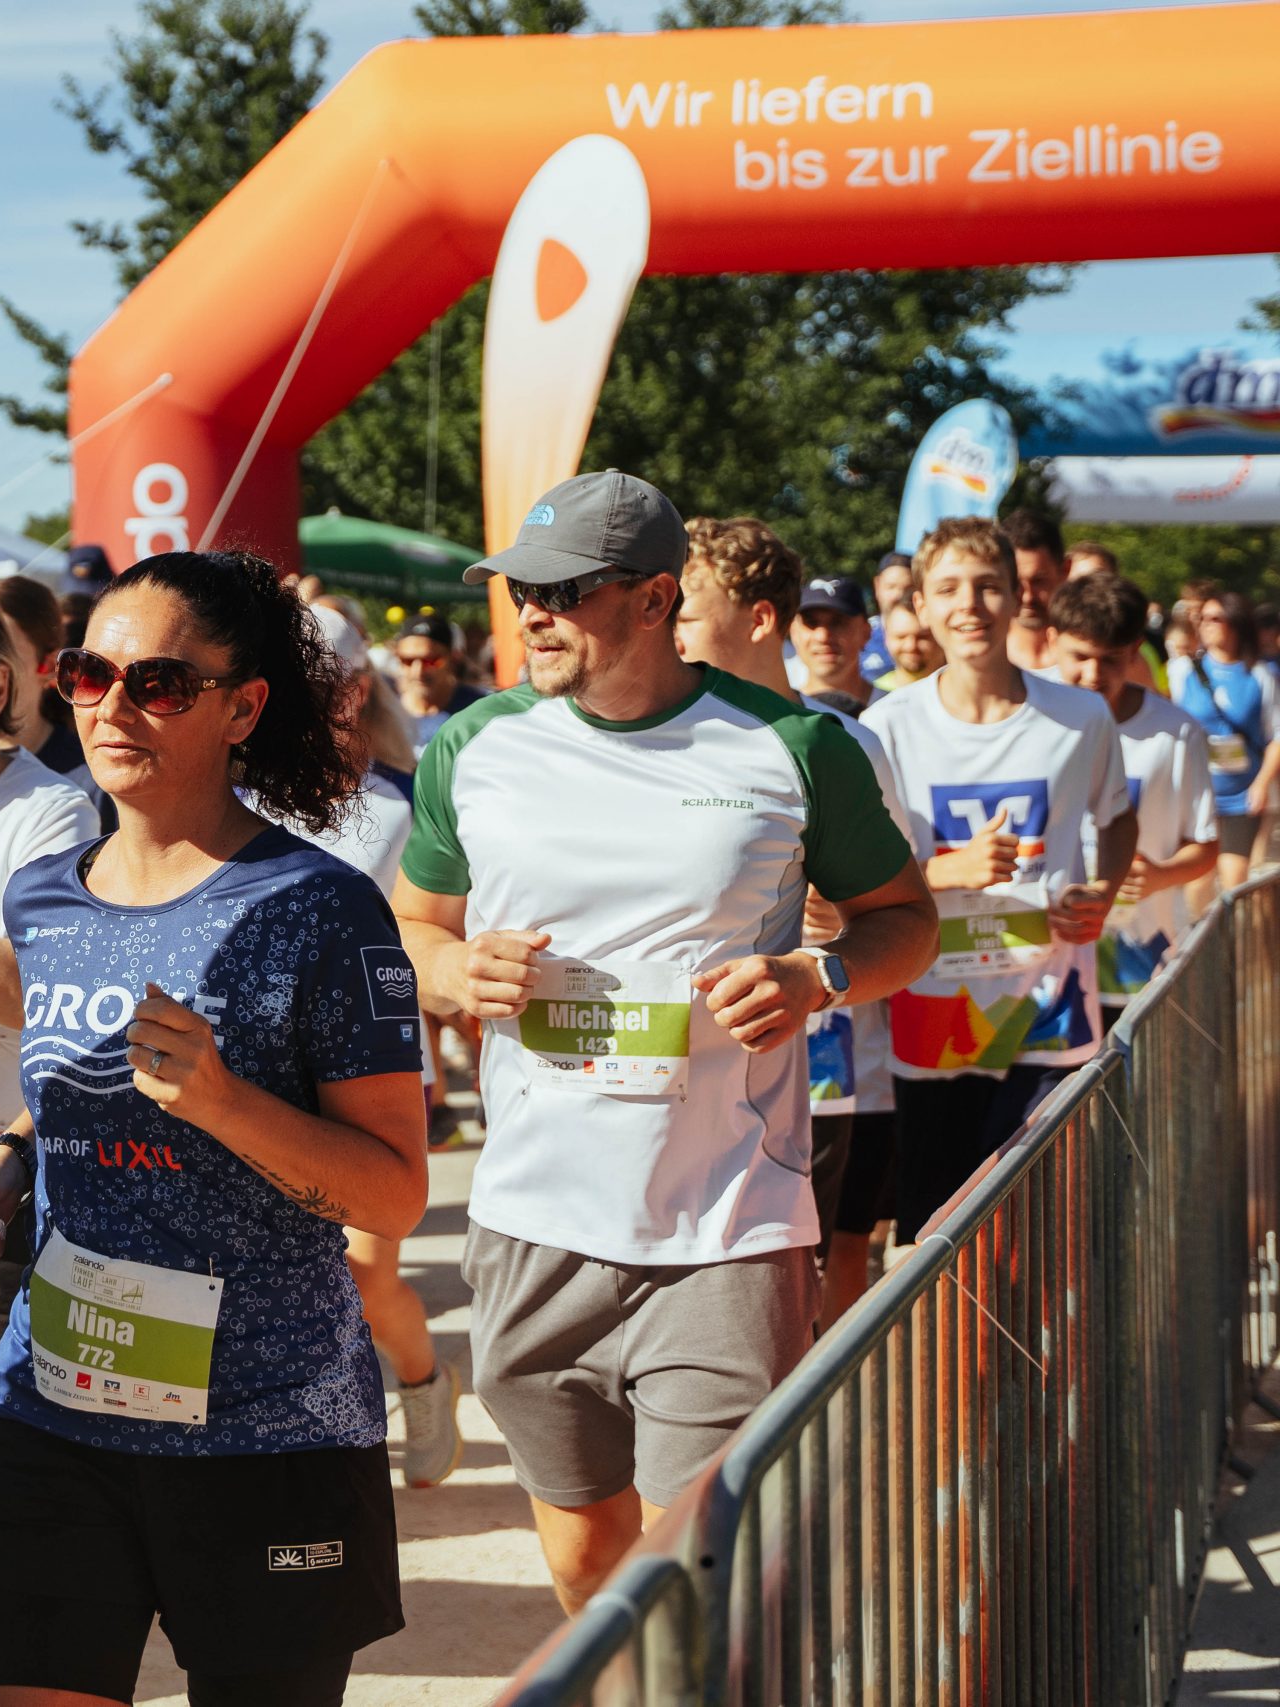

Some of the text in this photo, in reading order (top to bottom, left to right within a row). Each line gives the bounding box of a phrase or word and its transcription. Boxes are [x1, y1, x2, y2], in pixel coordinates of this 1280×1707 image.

[605, 75, 934, 130] Wir liefern
[734, 120, 1224, 190] bis zur Ziellinie
[681, 798, 755, 809] SCHAEFFLER
[376, 967, 413, 982] GROHE
[24, 982, 228, 1046] GROE
[547, 1003, 650, 1031] Michael
[575, 1036, 619, 1054] 1429
[70, 1139, 91, 1156] OF
[96, 1139, 183, 1170] LIXIL
[73, 1254, 105, 1272] zalando
[74, 1266, 94, 1279] FIRMEN
[72, 1274, 93, 1289] LAUF
[66, 1299, 135, 1347] Nina
[33, 1350, 67, 1380] zalando
[77, 1343, 115, 1370] 772
[165, 1391, 180, 1400] dm
